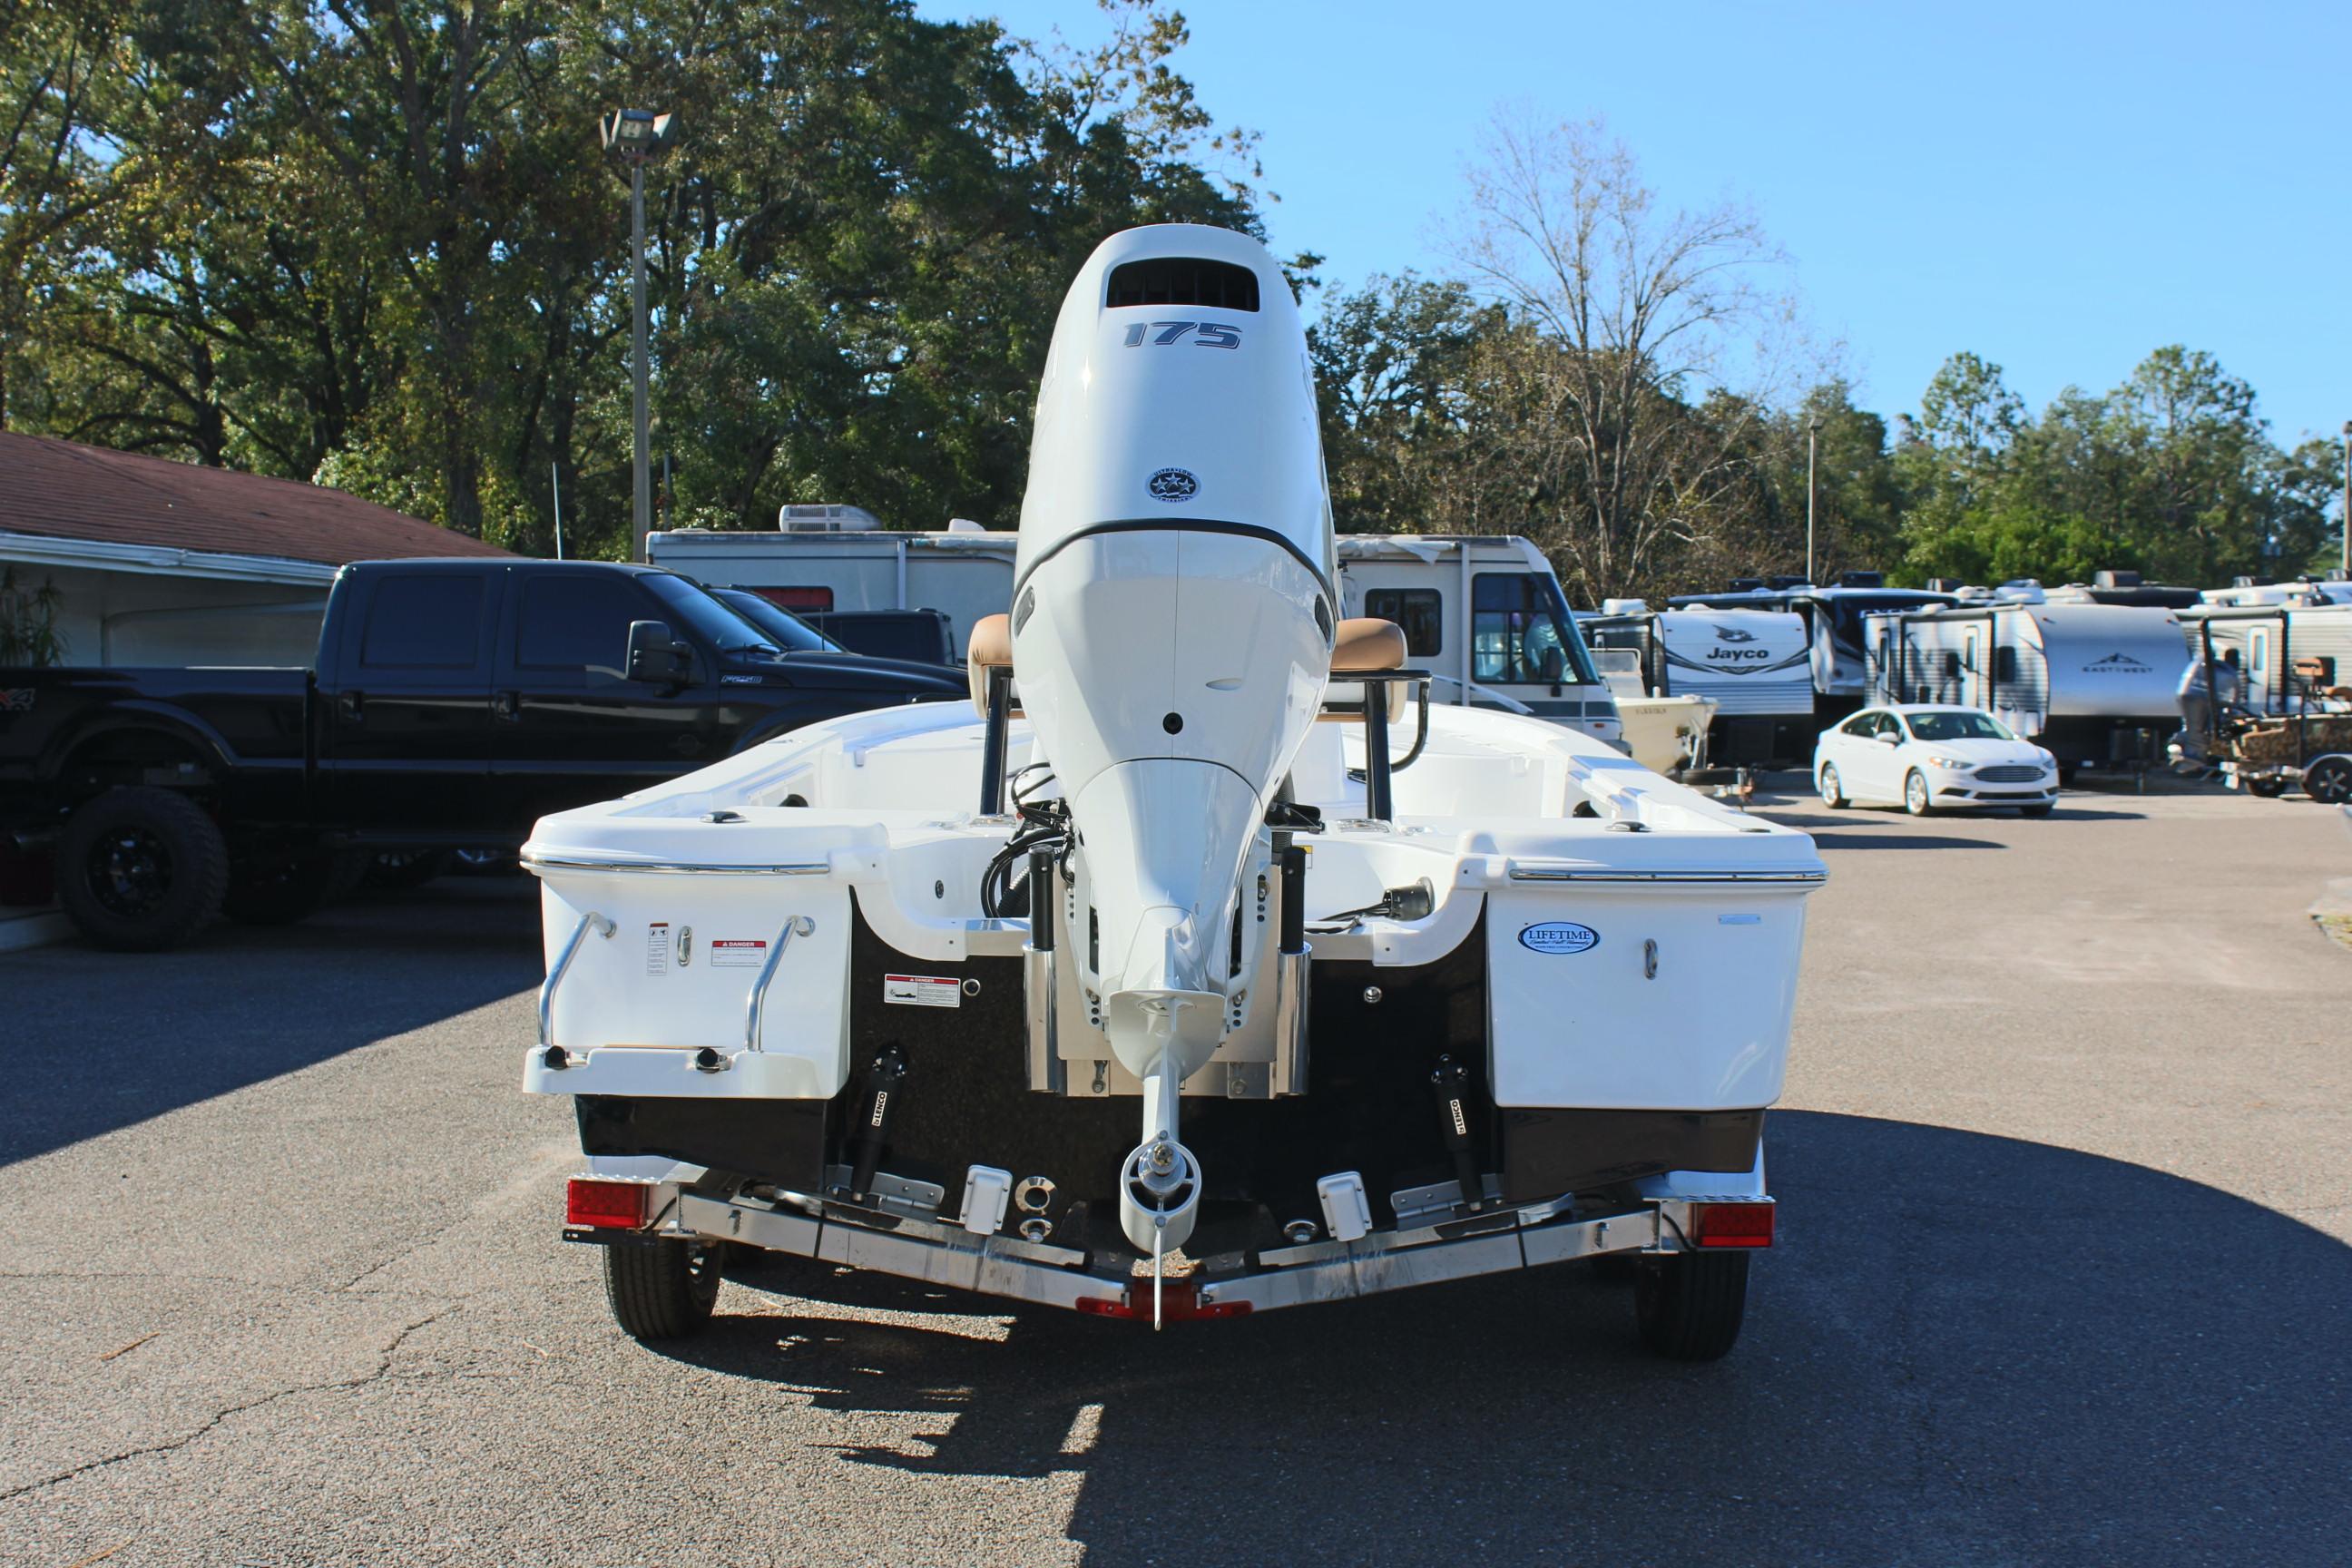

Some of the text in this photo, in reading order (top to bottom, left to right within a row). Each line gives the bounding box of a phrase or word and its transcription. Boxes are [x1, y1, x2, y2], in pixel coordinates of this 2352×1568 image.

[1122, 320, 1242, 349] 175
[1707, 647, 1769, 662] Jayco
[1528, 930, 1591, 940] LIFETIME
[874, 1093, 886, 1119] LENCO
[1451, 1100, 1464, 1127] LENCO
